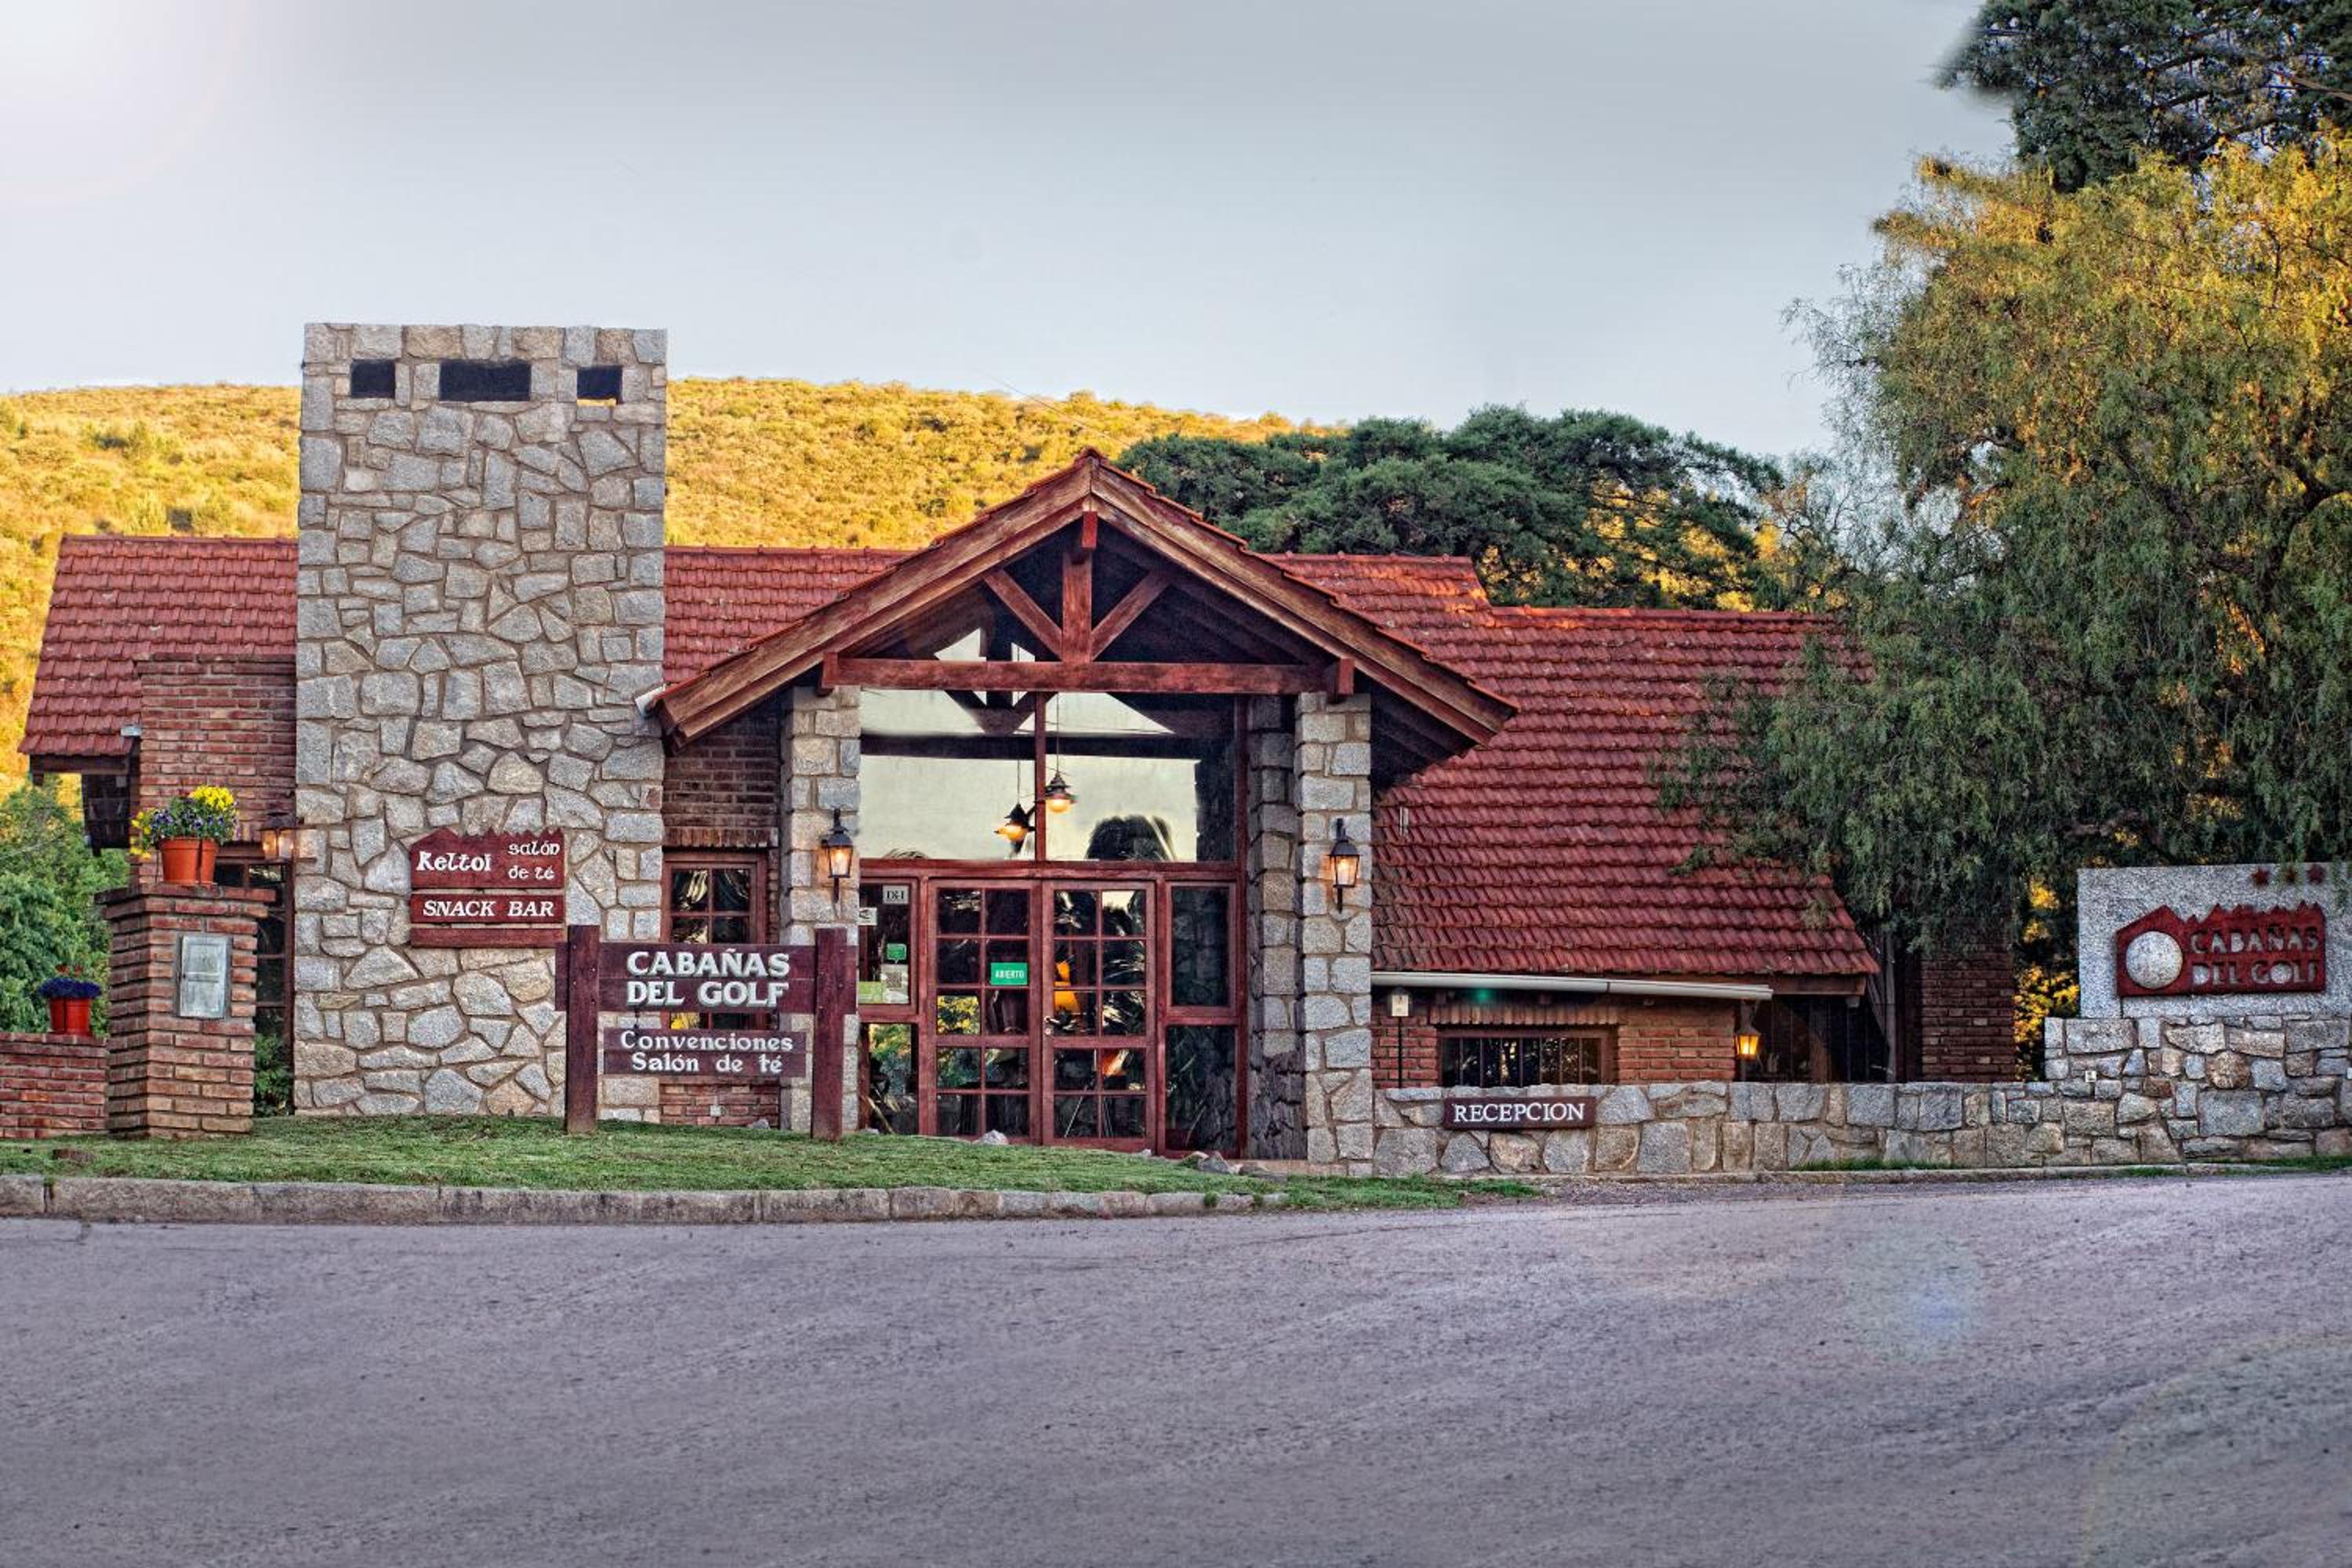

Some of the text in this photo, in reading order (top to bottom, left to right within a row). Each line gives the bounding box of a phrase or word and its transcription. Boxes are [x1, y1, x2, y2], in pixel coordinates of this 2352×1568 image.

[416, 851, 492, 872] Keltoi
[508, 866, 529, 880] de
[423, 901, 554, 916] SNACK BAR
[627, 948, 790, 977] CABAÑAS
[995, 969, 1025, 979] ABIERTO
[627, 982, 789, 1007] DEL GOLF
[620, 1031, 793, 1052] Convenciones
[632, 1053, 783, 1073] Salón de té
[1453, 1102, 1585, 1123] RECEPCION
